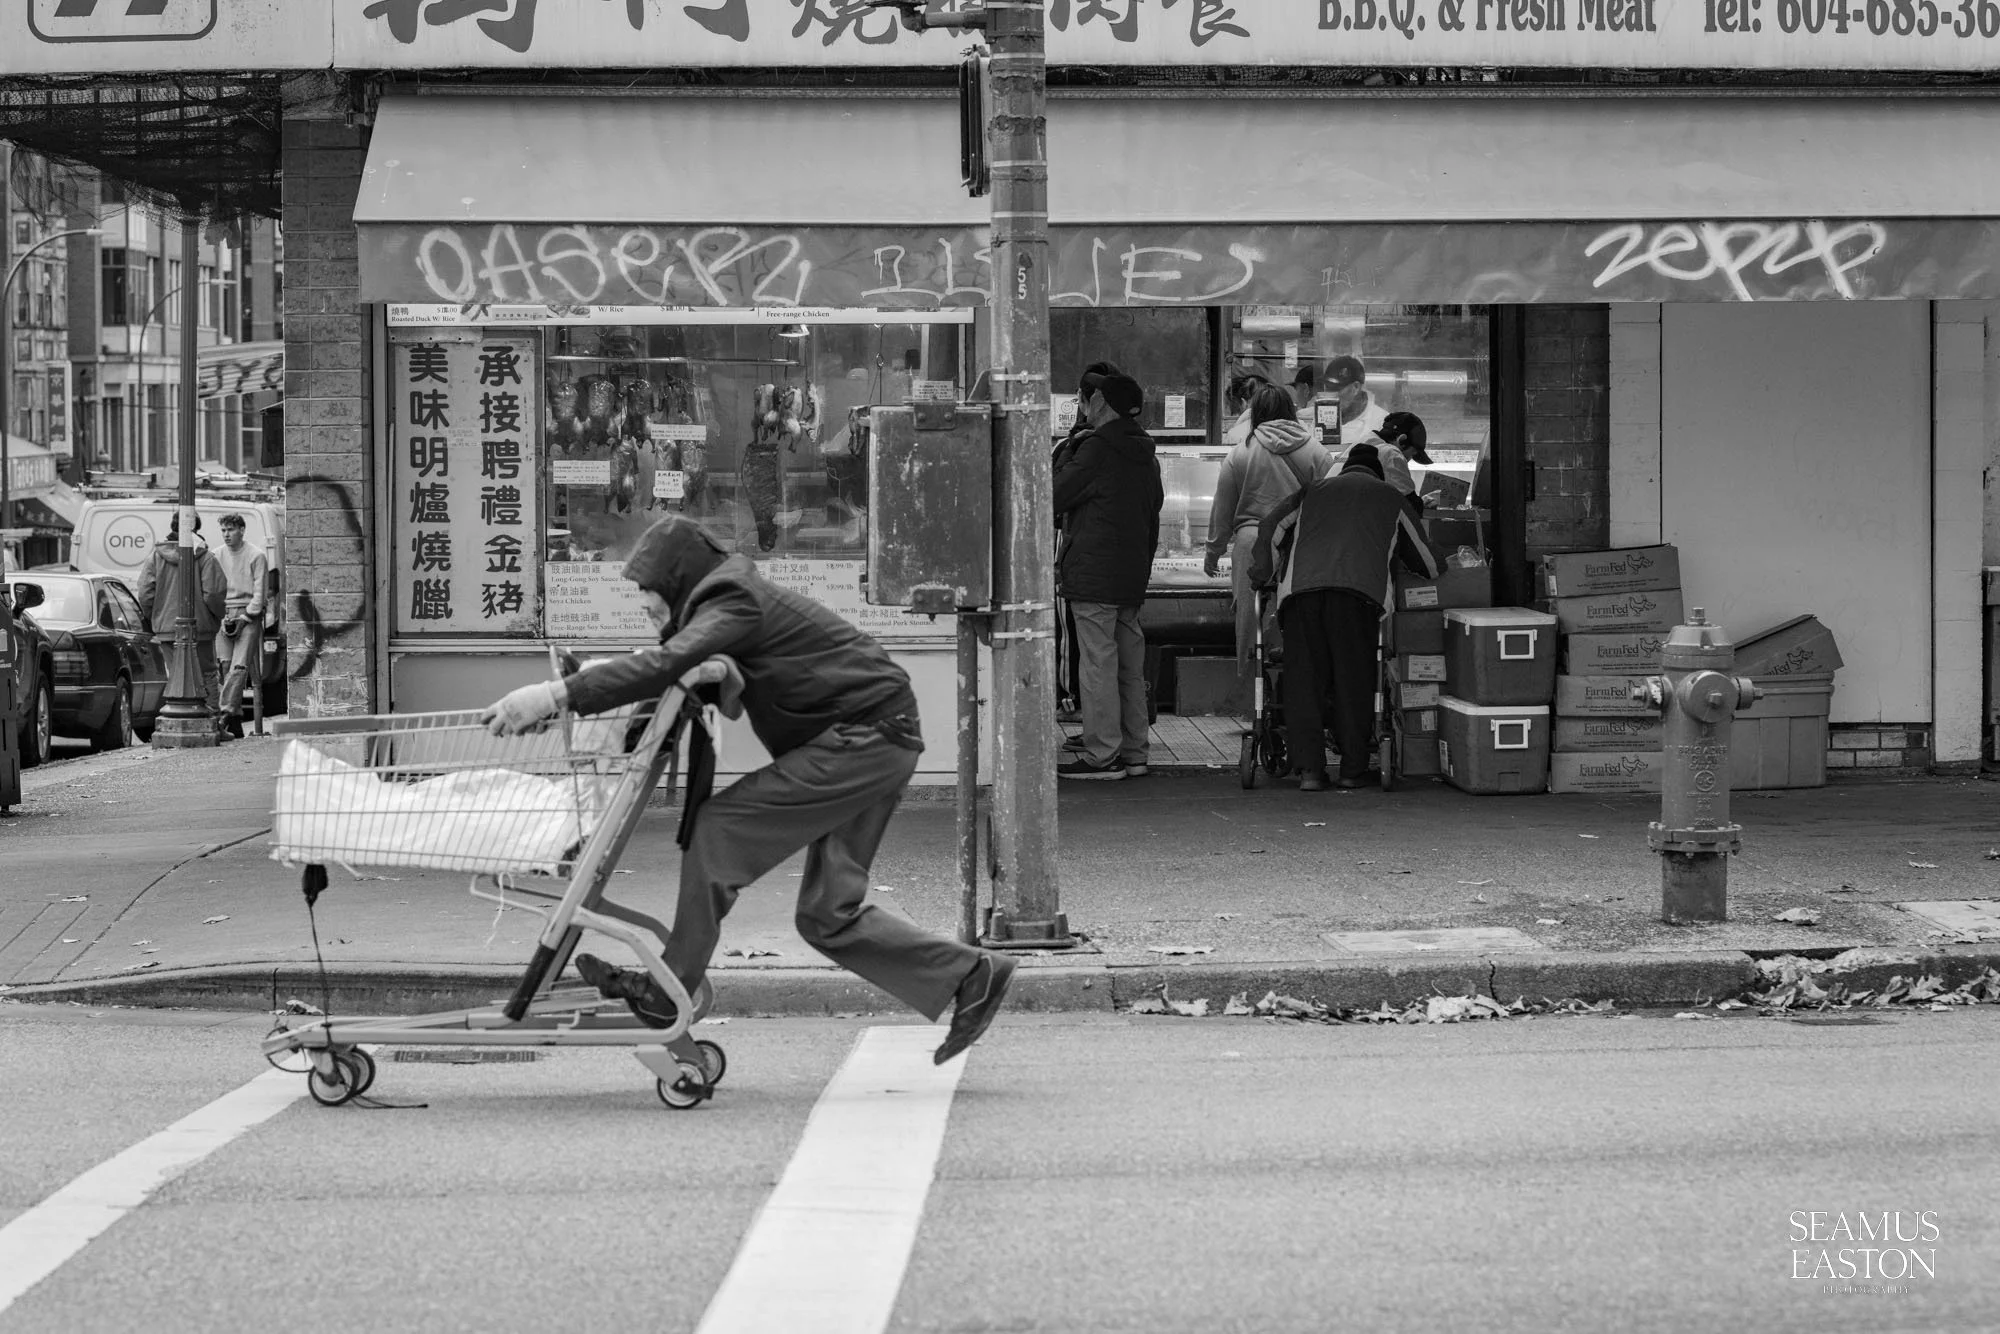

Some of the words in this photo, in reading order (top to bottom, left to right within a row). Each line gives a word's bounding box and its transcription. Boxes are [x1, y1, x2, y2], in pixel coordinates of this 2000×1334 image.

[1438, 0, 1465, 31] &
[766, 311, 801, 319] Free-range
[802, 310, 830, 318] Chicken
[409, 342, 453, 620] 美味明爐燒臘
[479, 345, 524, 619] 承接聘禮金豬
[109, 535, 145, 548] one
[1584, 561, 1626, 574] FarmFed
[1586, 604, 1628, 615] FarmFed
[1597, 644, 1639, 656] FarmFed
[1584, 686, 1626, 696] FarmFed
[1584, 721, 1626, 732] FarmFed
[1579, 763, 1621, 773] FarmFed
